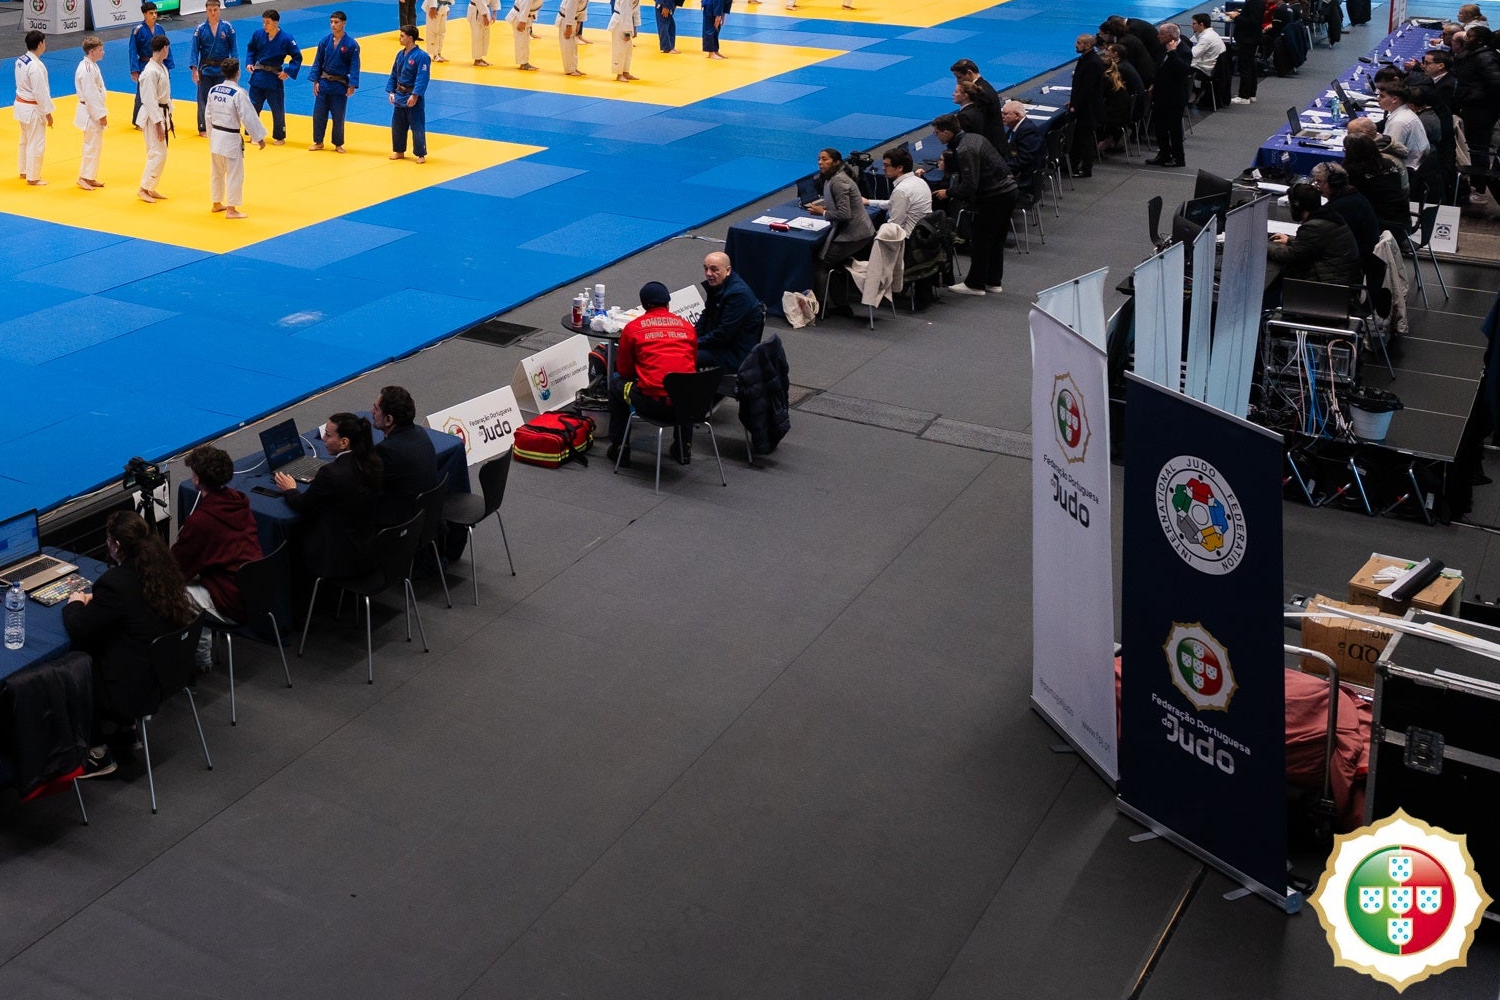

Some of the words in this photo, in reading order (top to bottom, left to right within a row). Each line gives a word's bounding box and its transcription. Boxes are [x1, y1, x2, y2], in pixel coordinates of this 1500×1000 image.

[30, 21, 46, 30] Judo
[63, 20, 77, 29] Judo
[214, 95, 227, 103] POR
[640, 316, 684, 328] BOMBEIROS
[479, 418, 512, 444] Judo
[1043, 454, 1068, 482] Federação
[1067, 475, 1099, 505] Portuguesa
[1186, 458, 1216, 478] JUDO
[1053, 473, 1090, 529] Judo
[1157, 464, 1192, 562] INTERNATIONAL
[1222, 493, 1246, 572] FEDERATION
[1151, 692, 1195, 726] Federação
[1196, 719, 1251, 756] Portuguesa
[1161, 716, 1173, 728] de
[1166, 712, 1235, 775] Judo
